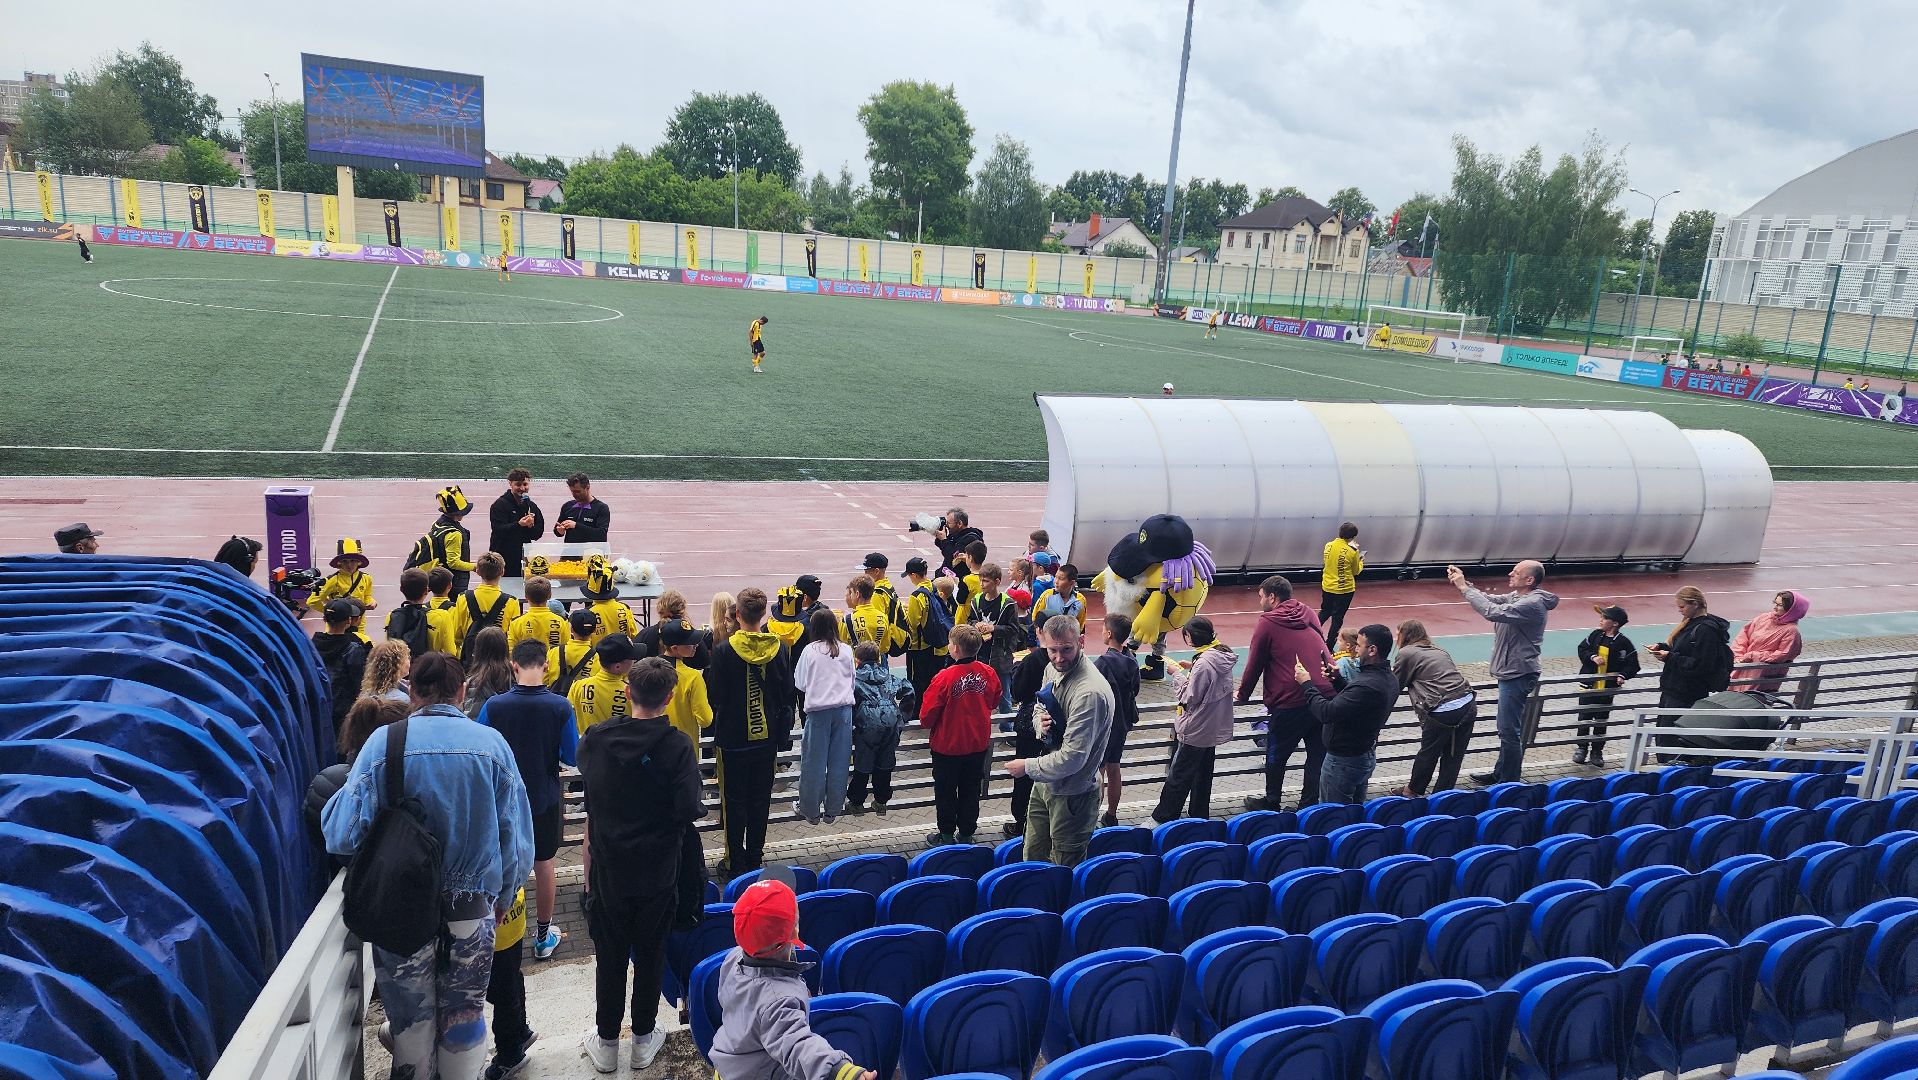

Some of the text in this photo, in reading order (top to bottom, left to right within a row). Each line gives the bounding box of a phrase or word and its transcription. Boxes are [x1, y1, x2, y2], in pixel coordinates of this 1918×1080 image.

[118, 232, 174, 245] ВЕЛЕС
[214, 239, 267, 252] ВЕЛЕС
[608, 266, 659, 280] KELME
[1228, 312, 1258, 328] LEON
[1273, 323, 1299, 334] ВЕЛЕС
[1516, 353, 1541, 363] ТОЛЬКО
[1578, 364, 1594, 374] ВСК
[1687, 376, 1748, 396] ВЕЛЕС
[280, 529, 298, 566] TV DDD
[550, 619, 561, 629] FC
[854, 616, 866, 629] 15
[582, 684, 595, 701] 16
[613, 689, 627, 703] FC
